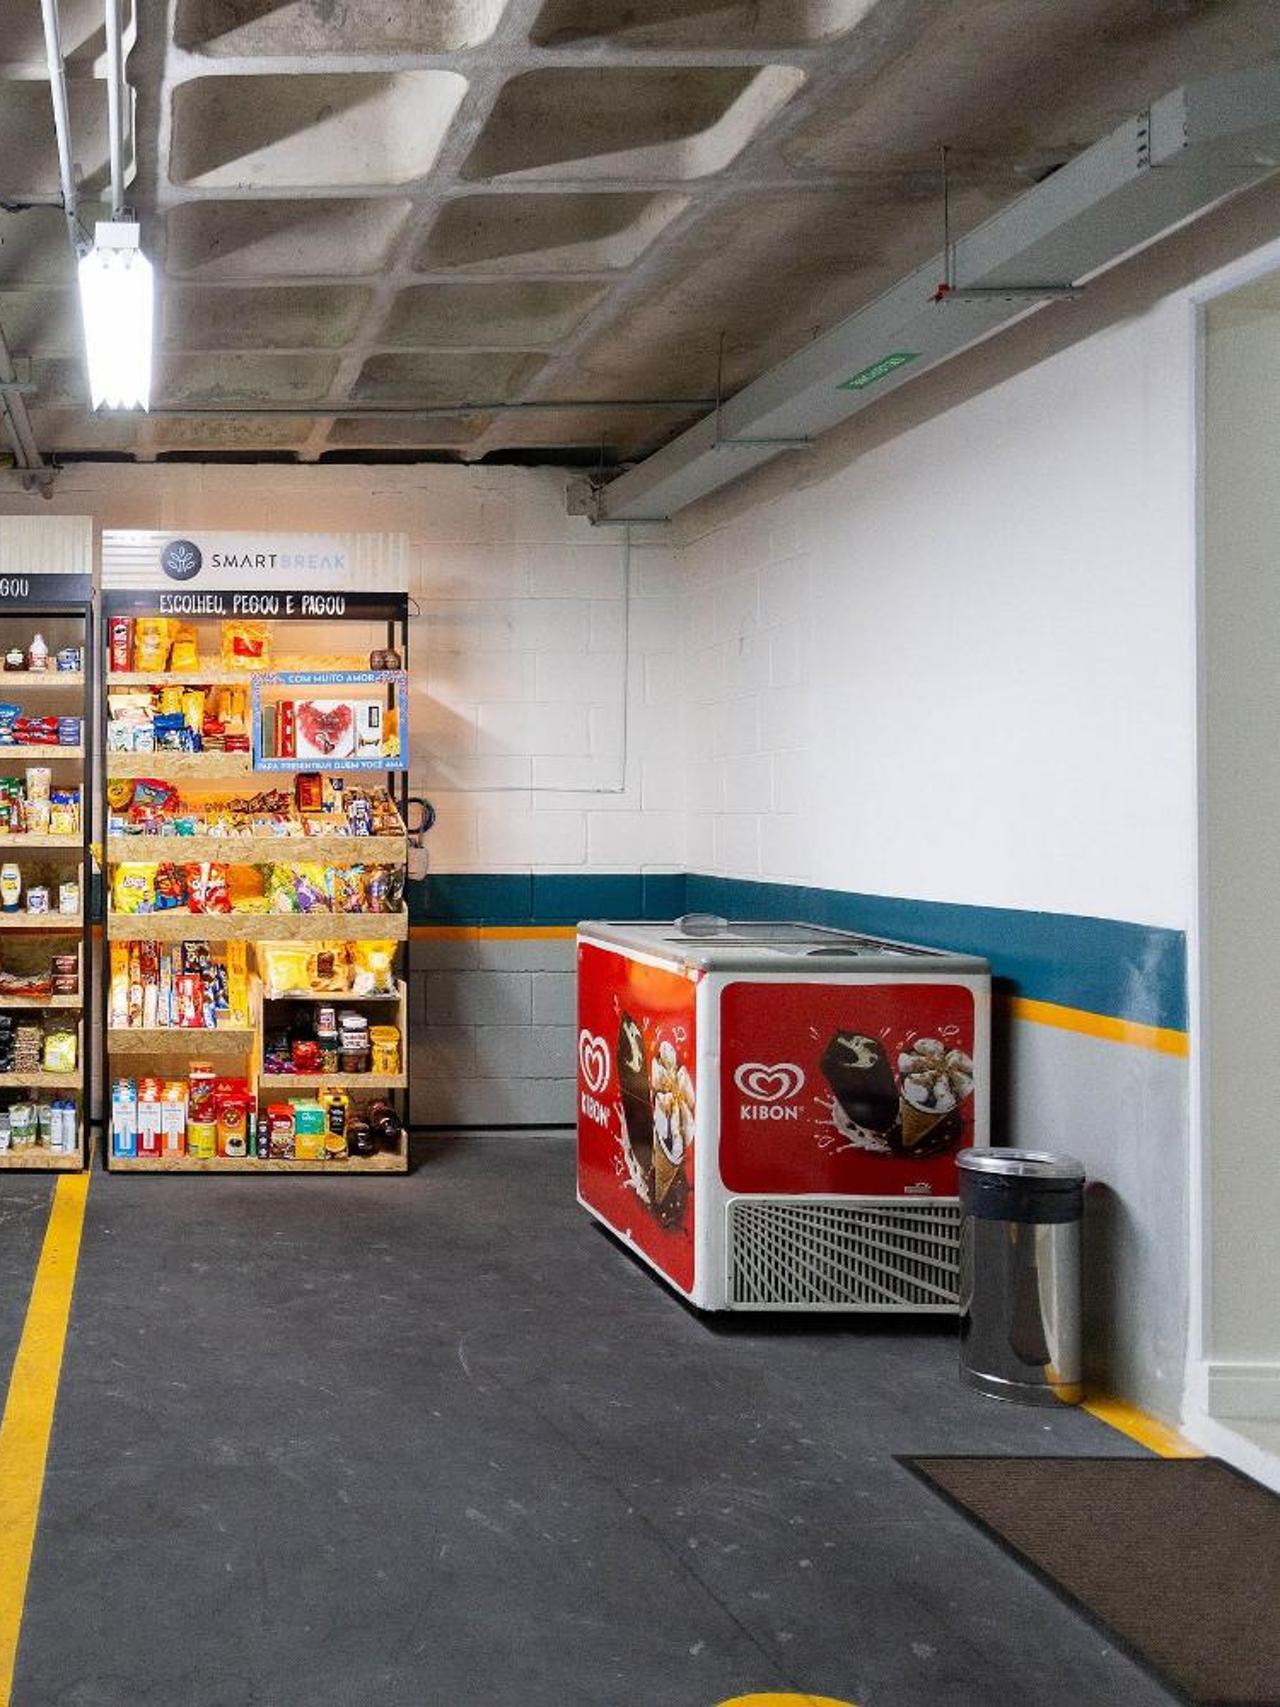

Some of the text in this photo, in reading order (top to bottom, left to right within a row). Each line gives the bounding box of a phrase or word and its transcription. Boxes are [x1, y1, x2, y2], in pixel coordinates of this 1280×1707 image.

[211, 554, 346, 569] SMARTBREAK
[160, 595, 346, 616] ESCOLHEU, PEGOU E PAGOU
[288, 673, 376, 685] COM MUITO AMOR
[581, 1091, 610, 1129] KIBON
[740, 1105, 798, 1120] KIBON
